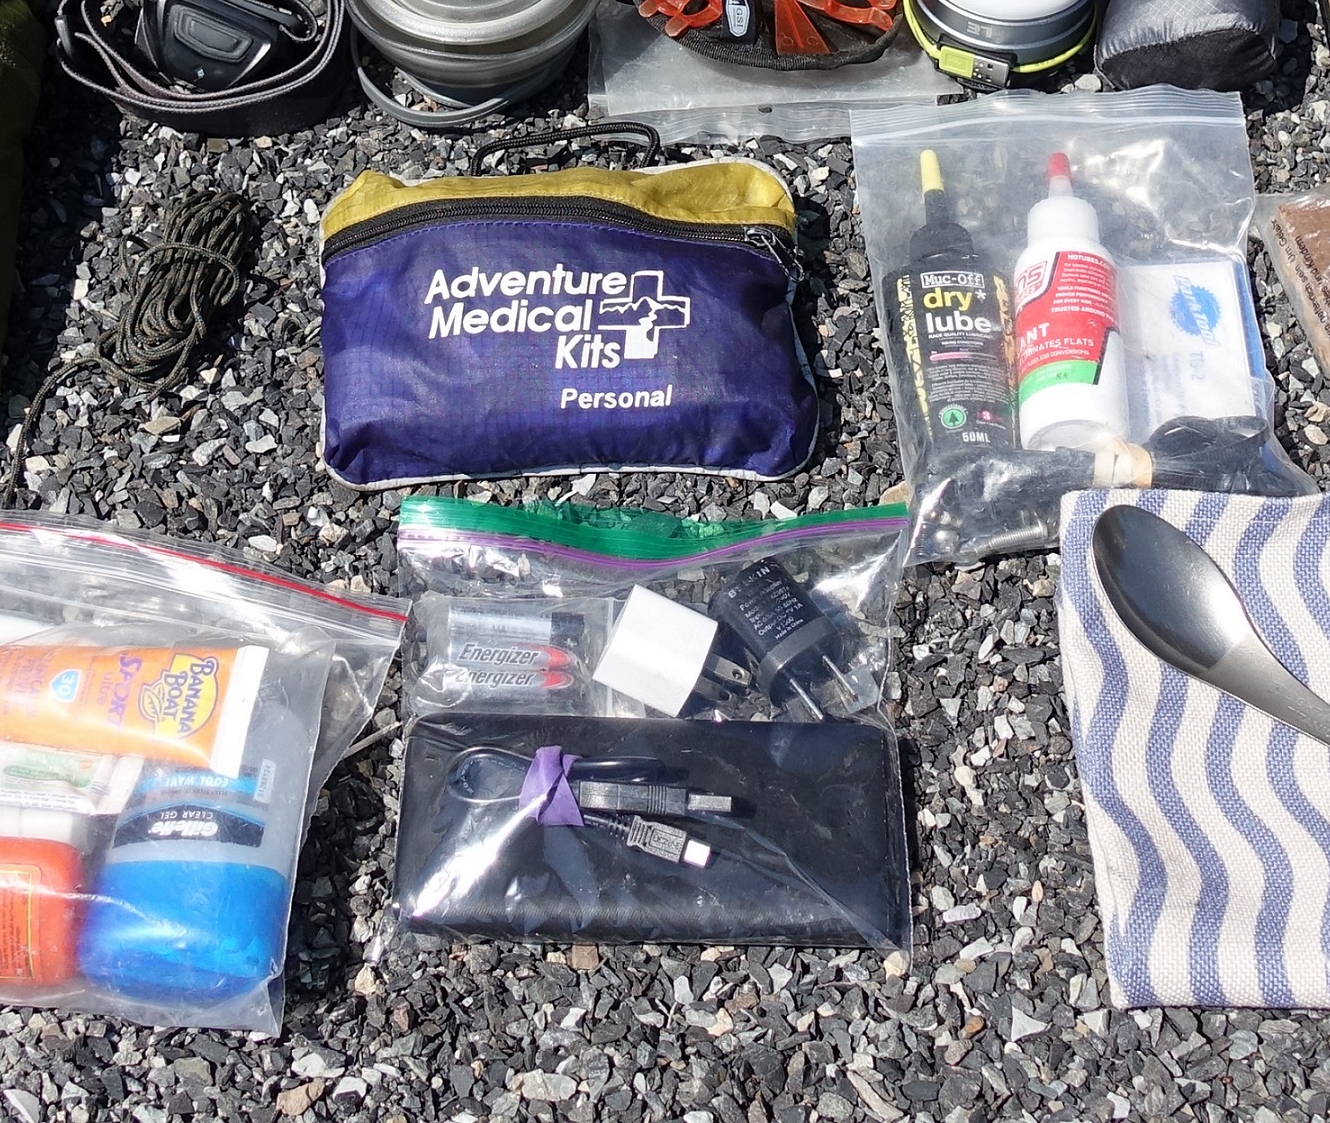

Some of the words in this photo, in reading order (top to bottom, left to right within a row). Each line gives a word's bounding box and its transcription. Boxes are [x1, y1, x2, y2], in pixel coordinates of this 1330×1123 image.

[736, 7, 744, 28] GSI
[424, 263, 627, 305] Adventure
[924, 274, 983, 287] Muc-Off
[428, 298, 593, 339] Medical
[925, 311, 992, 334] lube
[555, 334, 622, 369] Kits
[1064, 337, 1094, 347] FLATS
[560, 385, 673, 409] Personal
[962, 432, 991, 443] 50ML
[459, 643, 540, 666] Energizer
[58, 673, 75, 695] 30
[107, 653, 142, 727] SPORT
[163, 671, 189, 720] BOAT
[178, 659, 215, 734] BANANA
[160, 810, 178, 819] GEL
[182, 810, 214, 819] CLEAR
[153, 820, 219, 837] Gillette
